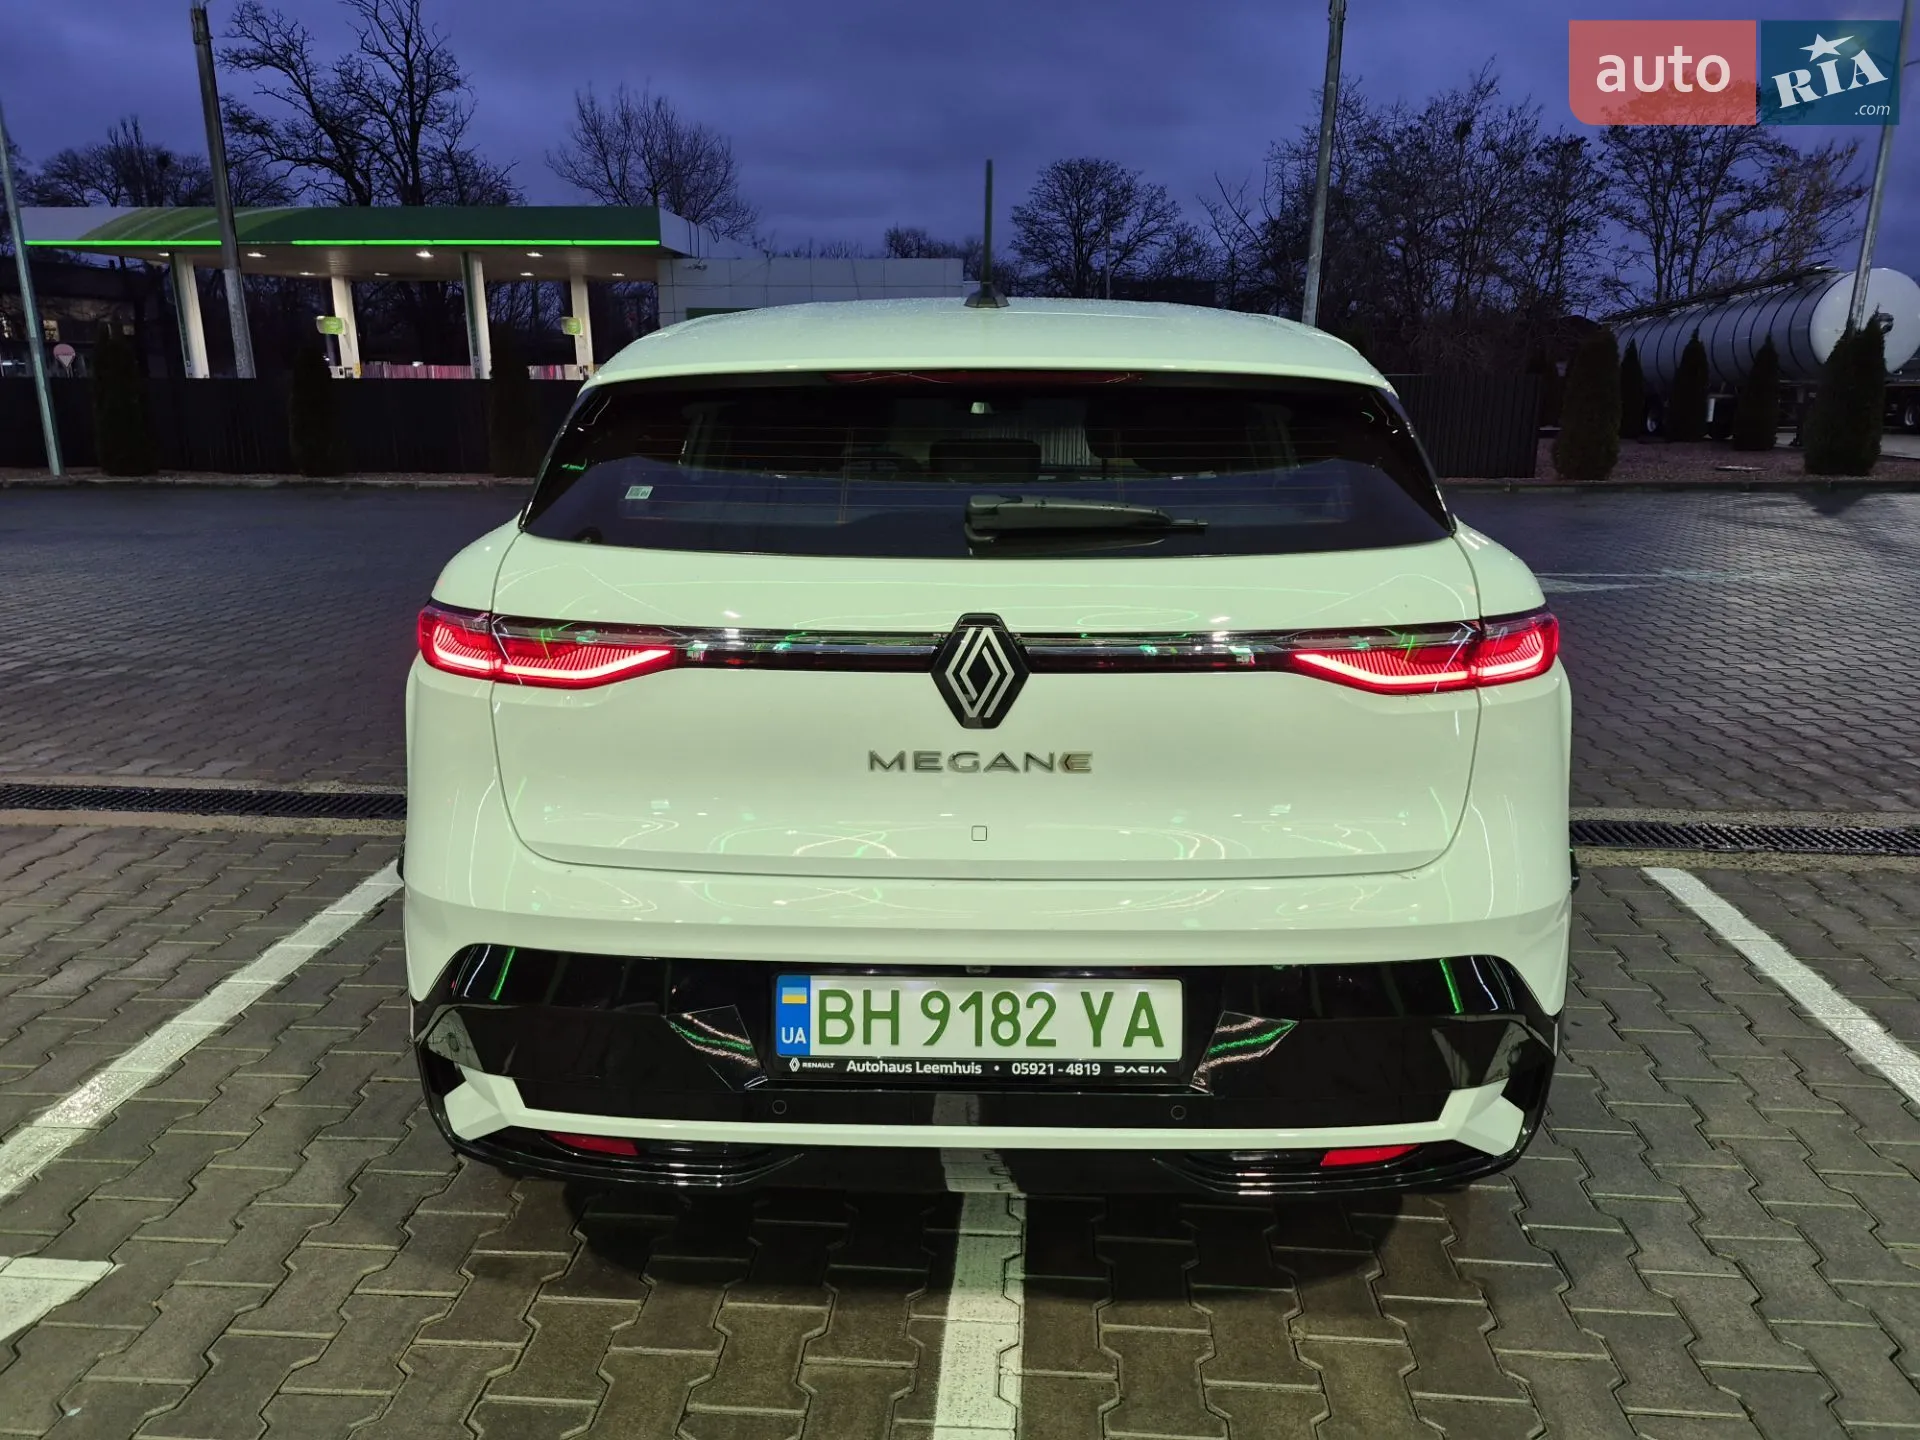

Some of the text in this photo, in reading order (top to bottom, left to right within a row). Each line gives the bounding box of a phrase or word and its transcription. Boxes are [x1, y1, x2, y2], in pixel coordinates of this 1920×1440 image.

[868, 750, 1093, 774] MEGANE
[818, 989, 1164, 1047] BH 9182 YA
[781, 1027, 806, 1044] UA
[802, 1062, 835, 1070] RENAULT
[846, 1060, 912, 1074] Autohaus
[916, 1061, 982, 1075] Leemhuis
[1011, 1062, 1054, 1076] 05921
[1065, 1062, 1101, 1076] 4819
[1114, 1066, 1167, 1074] DACIA
